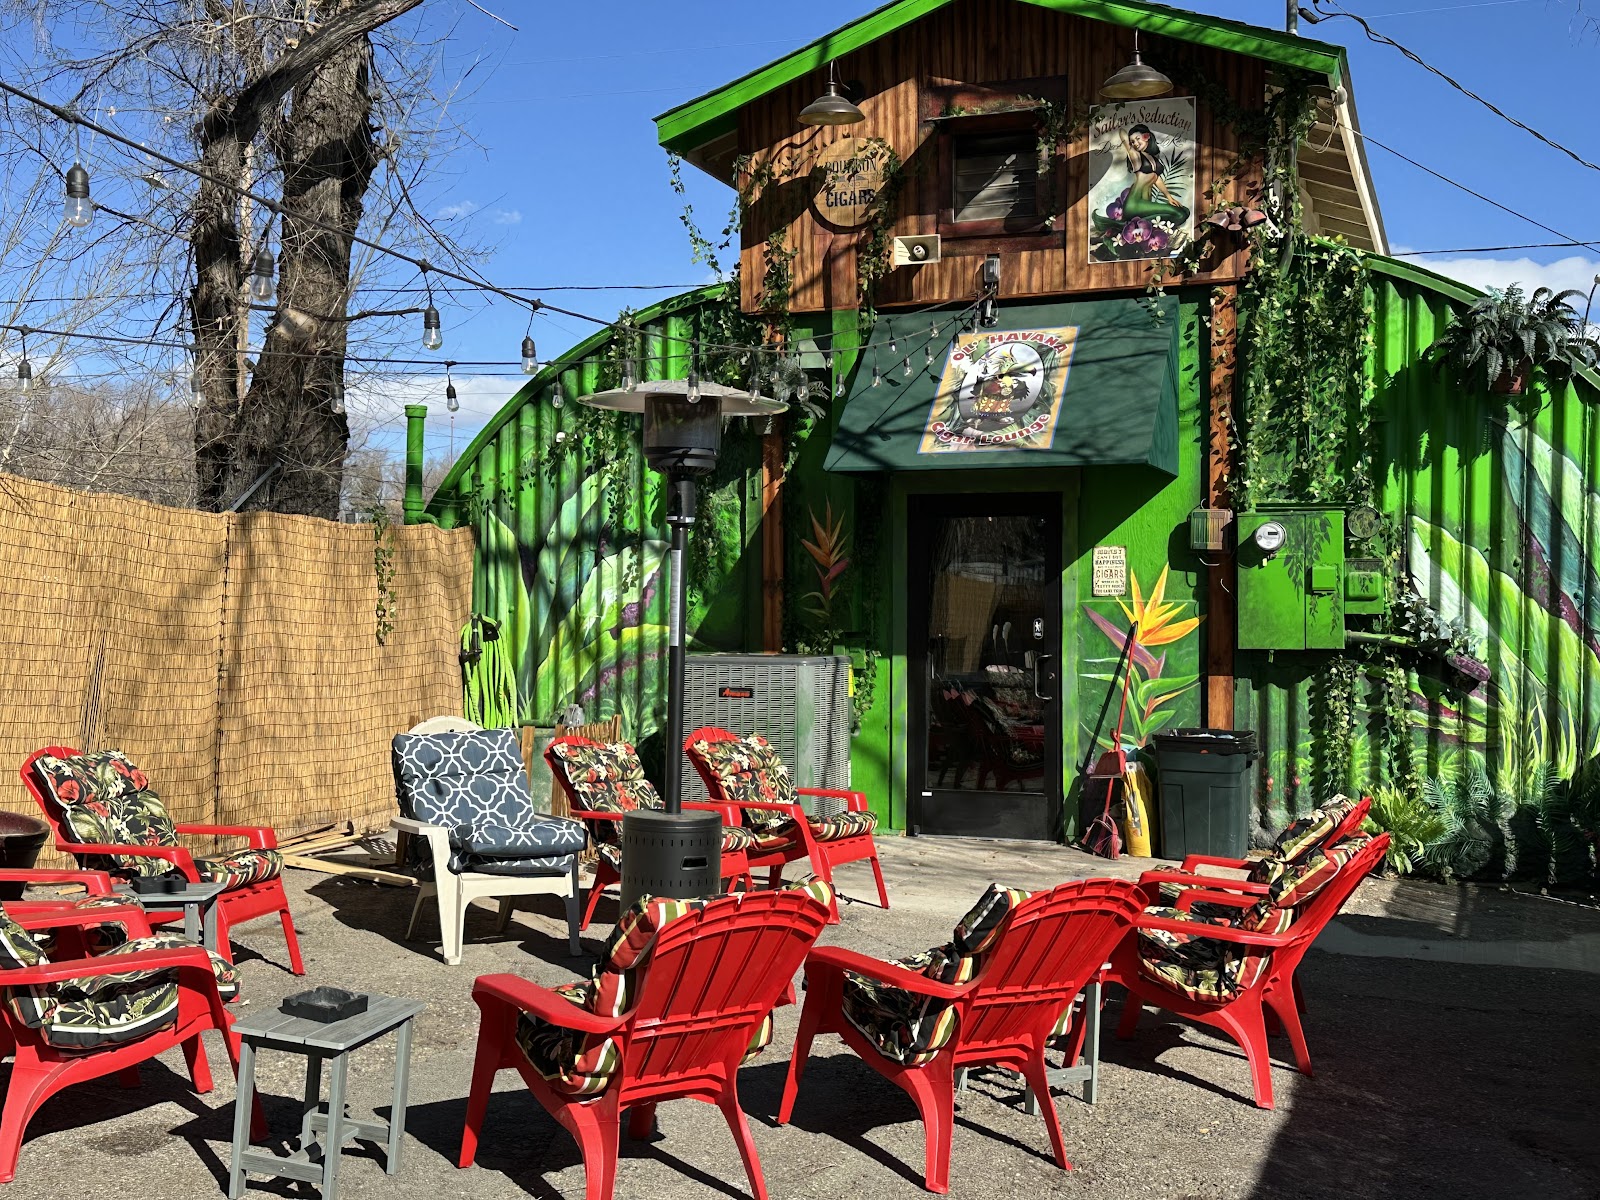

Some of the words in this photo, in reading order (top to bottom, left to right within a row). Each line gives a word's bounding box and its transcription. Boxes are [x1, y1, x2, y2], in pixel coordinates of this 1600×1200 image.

[1094, 111, 1136, 139] Sailor's
[1138, 105, 1192, 132] Seduction
[826, 189, 876, 207] CIGARS
[989, 332, 1069, 355] HAVANA
[931, 421, 976, 445] Cigar
[979, 413, 1051, 446] Lounge
[1095, 569, 1124, 579] CIGARS
